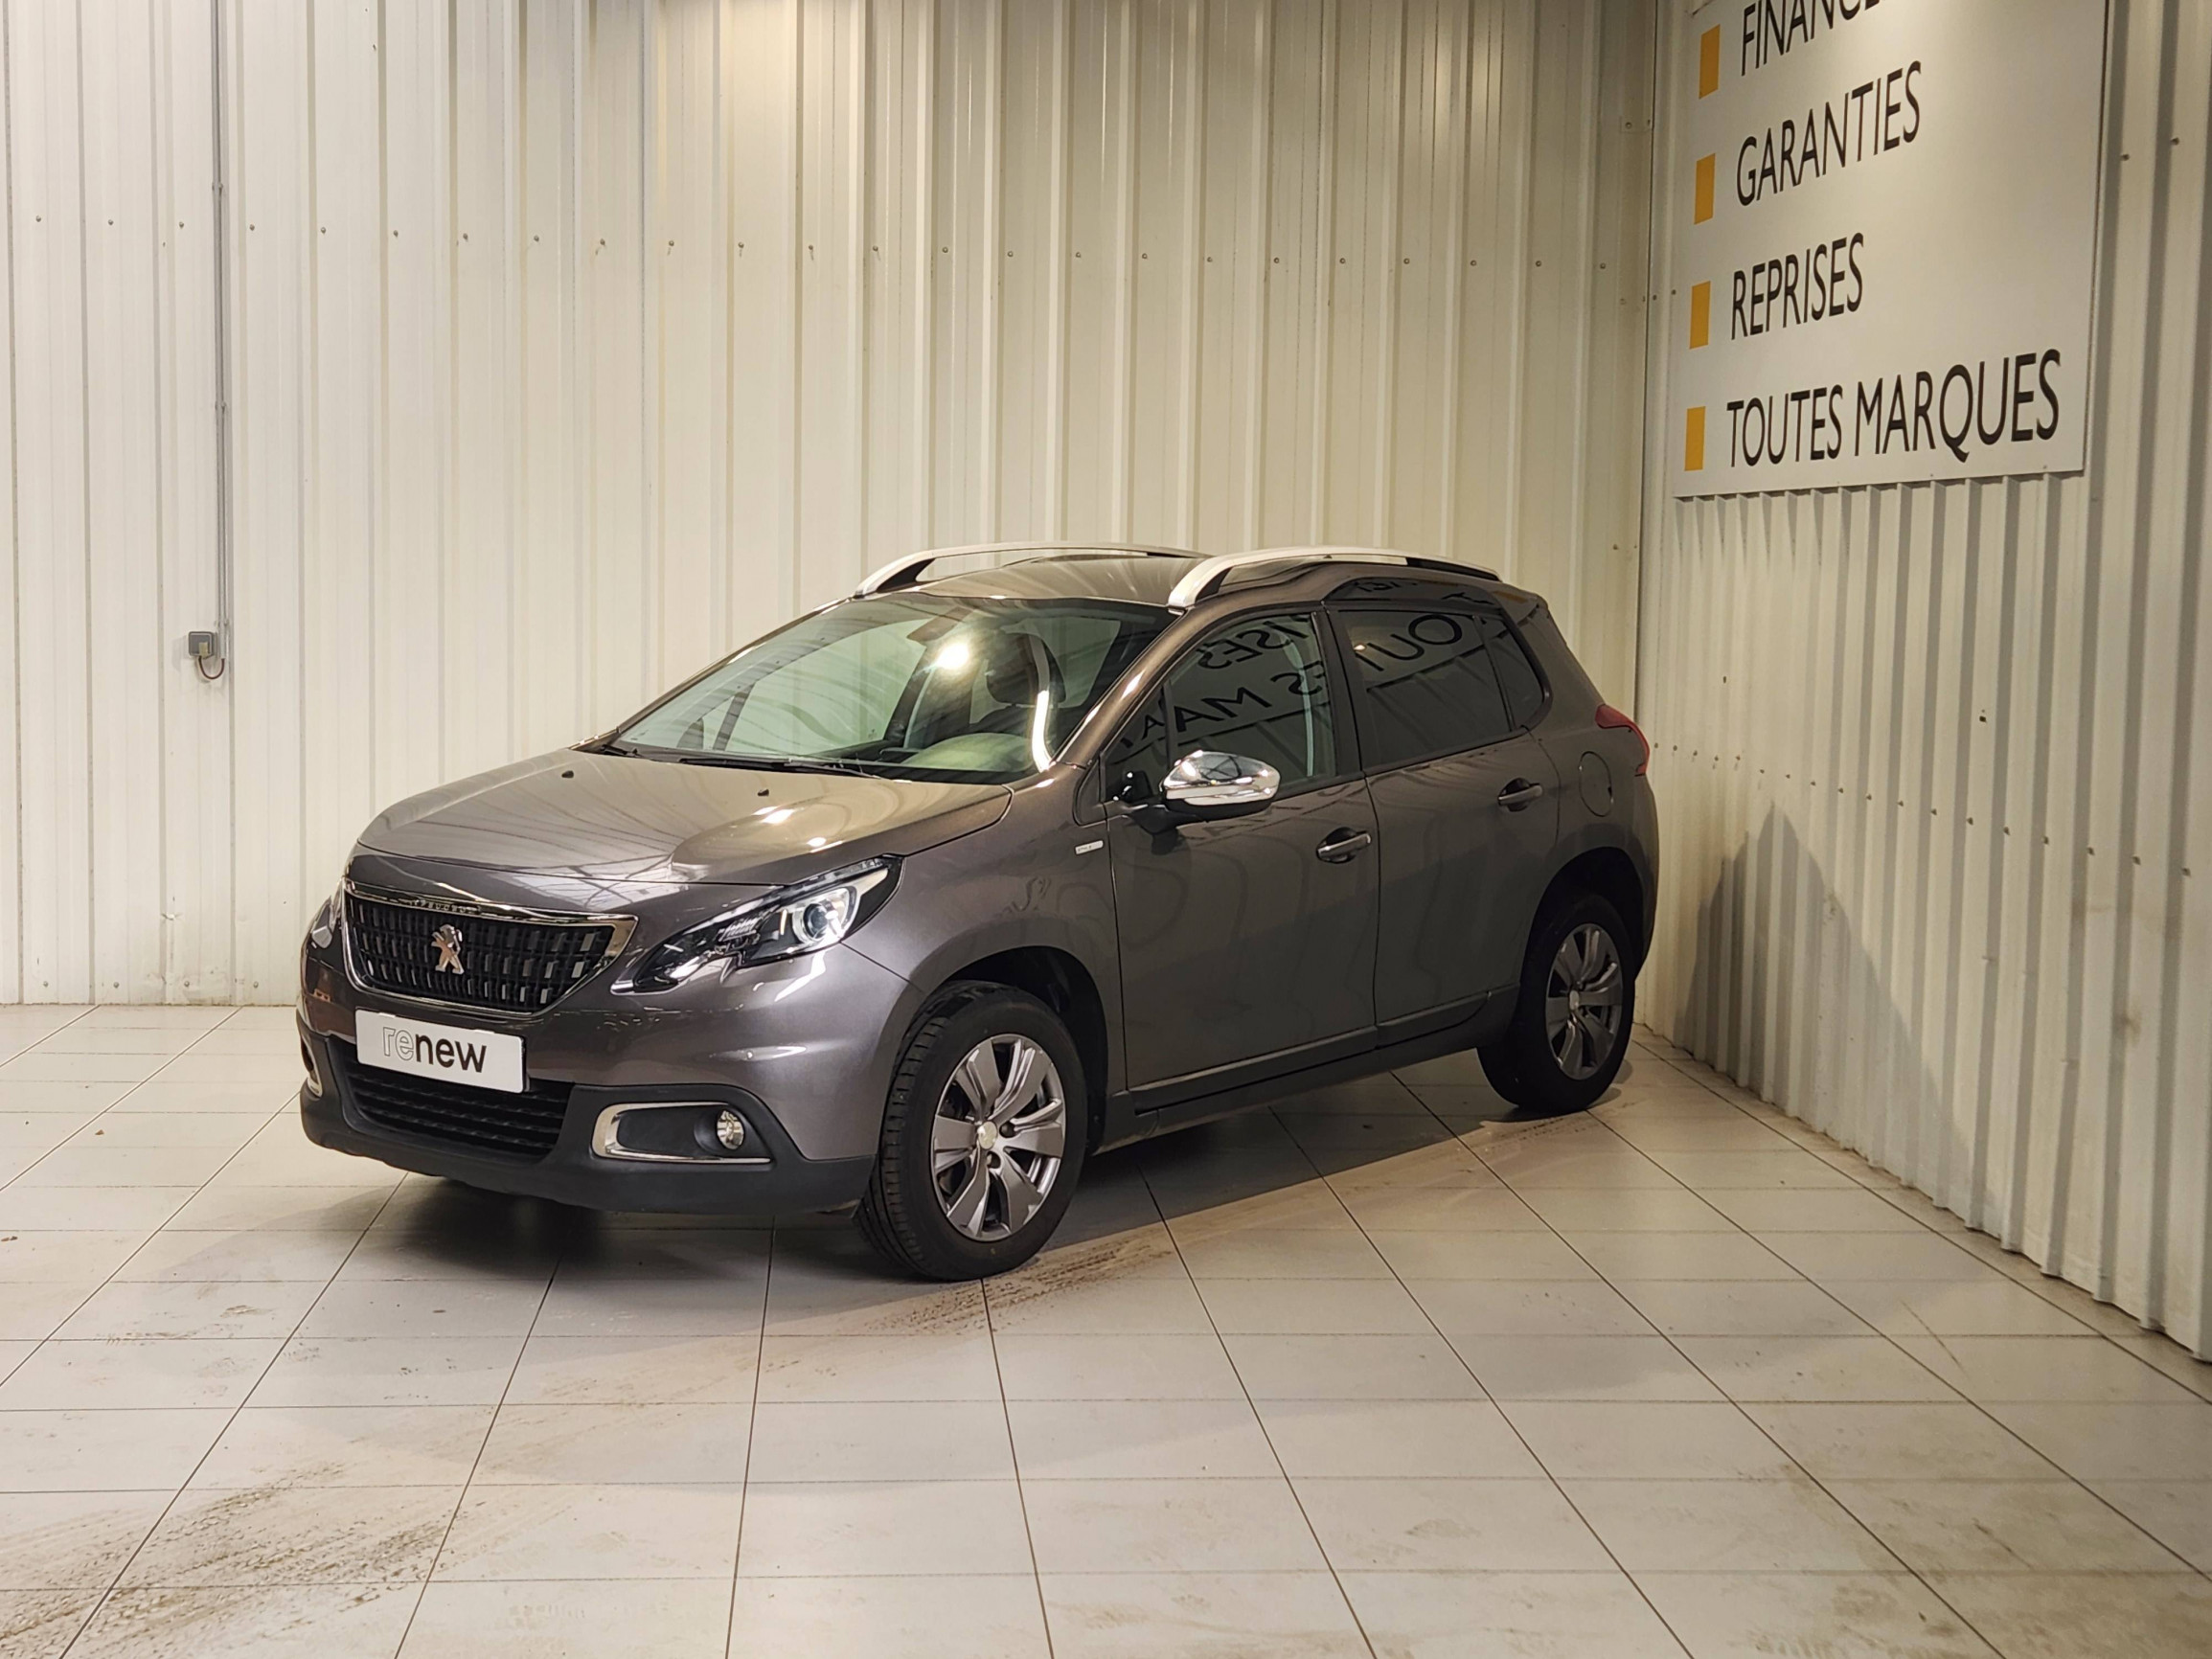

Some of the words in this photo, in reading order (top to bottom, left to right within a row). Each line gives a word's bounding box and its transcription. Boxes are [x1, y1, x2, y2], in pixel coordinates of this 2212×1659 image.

[1741, 0, 1881, 77] FINA
[1736, 60, 1922, 207] GARANTIES
[1731, 232, 1864, 340] REPRISES
[1726, 384, 1843, 467] TOUTES
[1854, 349, 2061, 464] MARQUES
[382, 1026, 488, 1074] renew
